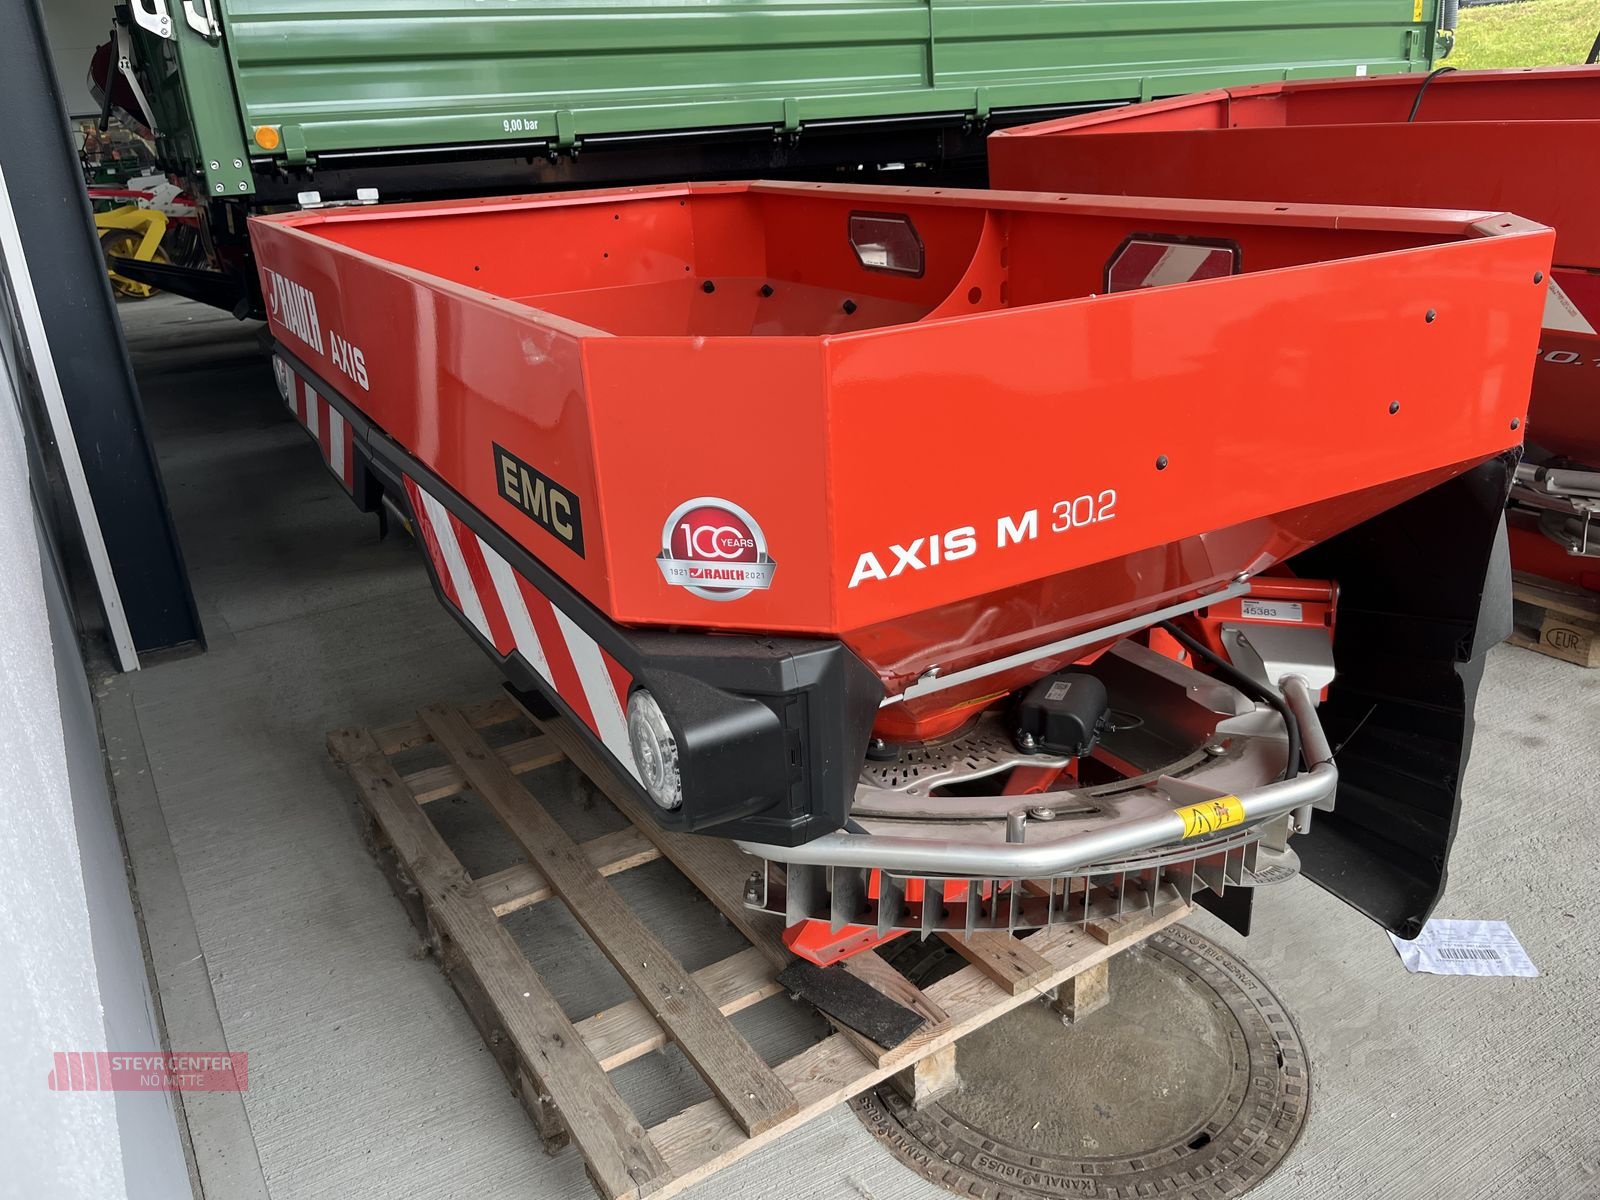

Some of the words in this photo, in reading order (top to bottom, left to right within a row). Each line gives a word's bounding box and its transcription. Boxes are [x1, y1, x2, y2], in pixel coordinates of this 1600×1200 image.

[503, 119, 522, 133] 9,00
[523, 118, 538, 130] bar
[275, 272, 324, 356] RAUCH
[329, 329, 369, 391] AXIS
[501, 454, 573, 541] EMC
[681, 523, 744, 559] 100
[721, 538, 754, 548] YEARS
[847, 526, 977, 589] AXIS
[997, 509, 1038, 548] M
[1052, 489, 1116, 533] 30.2
[670, 568, 688, 577] 1921
[703, 568, 745, 581] RAUCH
[745, 571, 765, 579] 2021
[1243, 607, 1277, 617] 45383
[1555, 631, 1579, 650] EUR
[1043, 1174, 1092, 1190] KANAL
